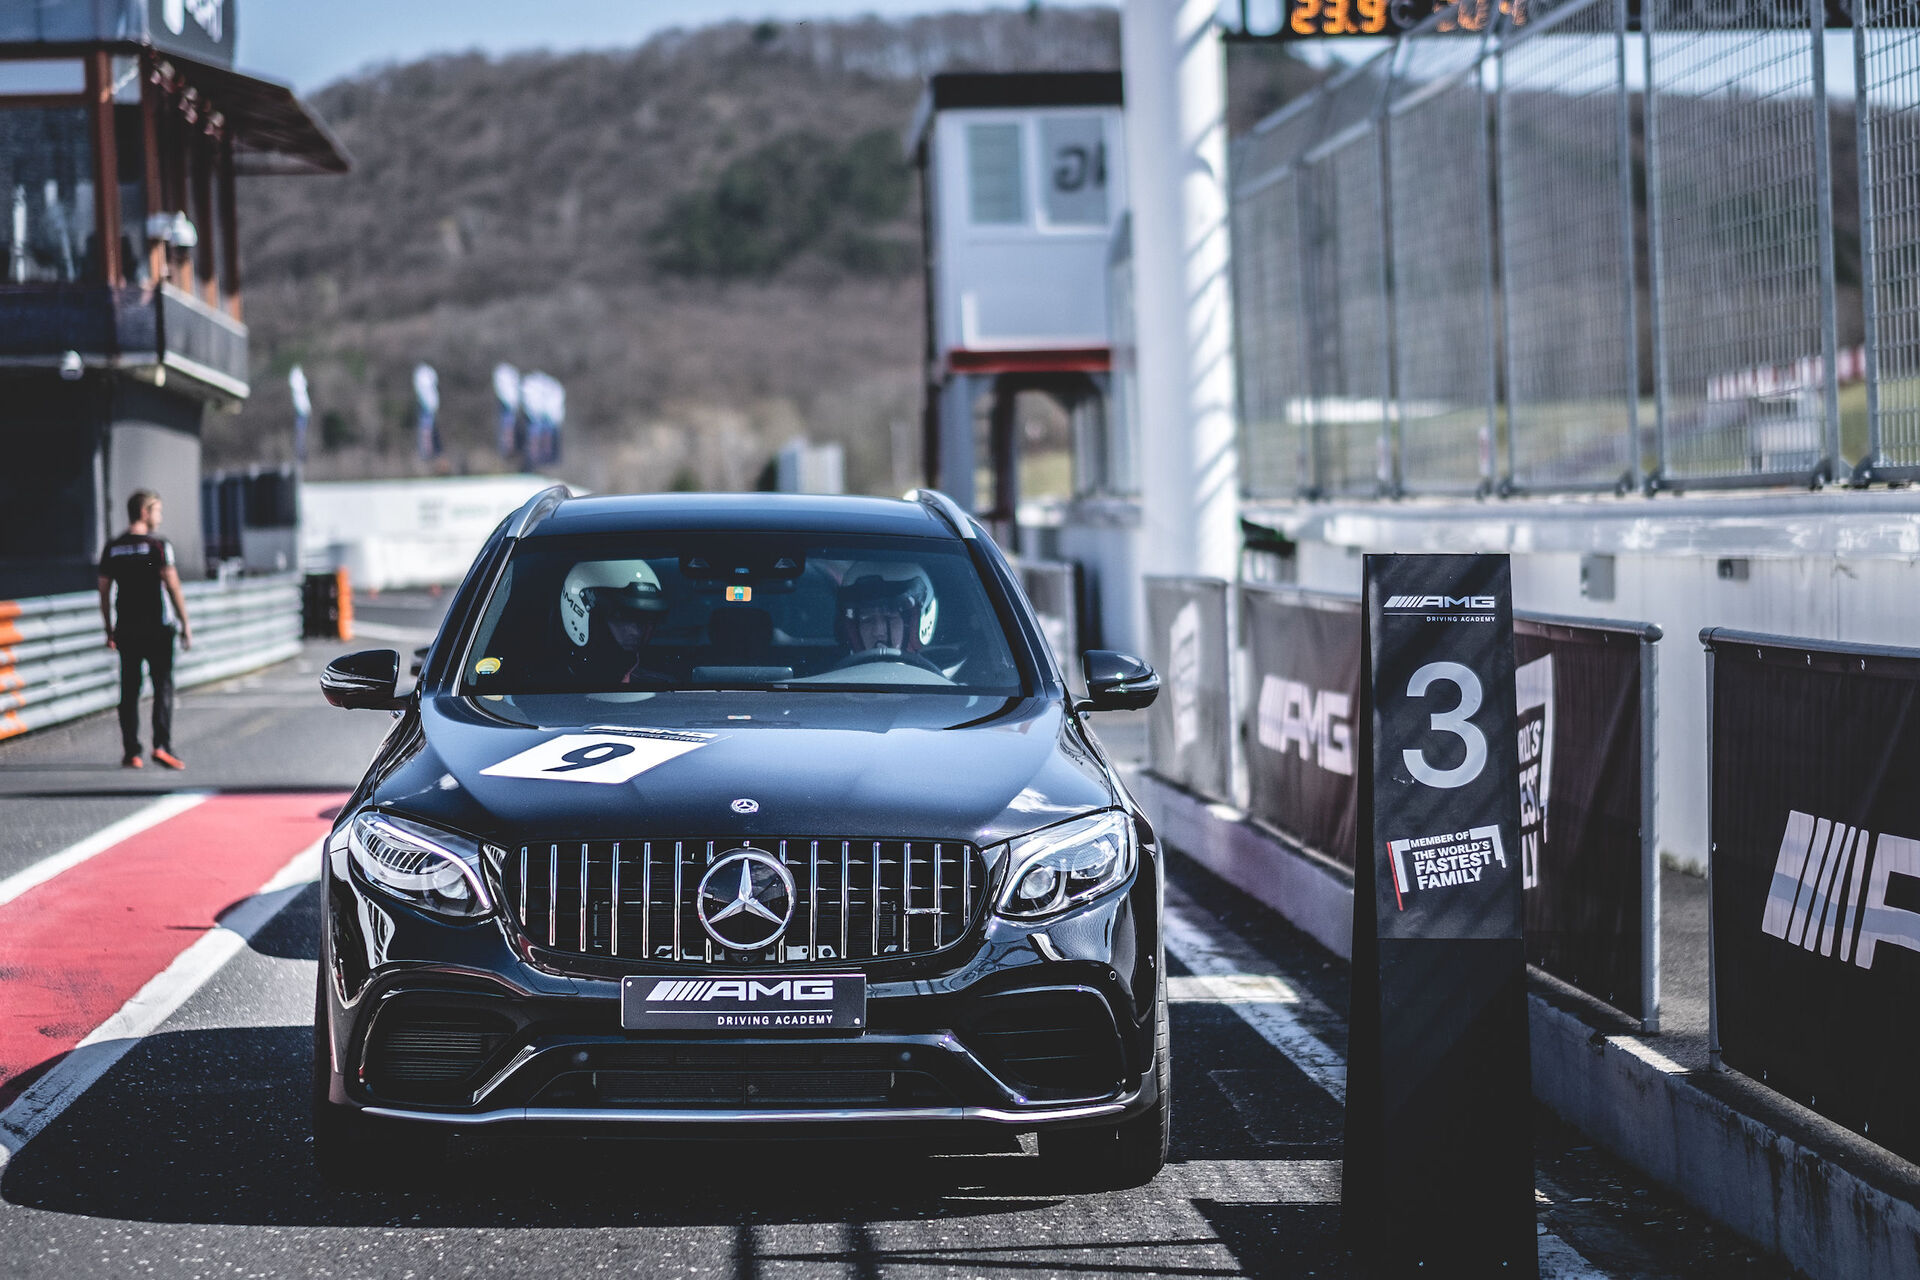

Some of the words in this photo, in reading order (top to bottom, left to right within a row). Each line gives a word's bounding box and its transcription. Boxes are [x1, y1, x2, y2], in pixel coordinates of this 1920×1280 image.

[1422, 595, 1496, 608] AMG
[1281, 682, 1353, 776] AMG
[1402, 661, 1488, 789] 3
[541, 742, 636, 773] 9
[1410, 834, 1454, 848] MEMBER
[1454, 831, 1470, 842] OF
[1413, 849, 1435, 860] THE
[1436, 840, 1491, 858] WORLD'S
[1414, 851, 1492, 876] FASTEST
[1417, 867, 1483, 892] FAMILY
[702, 980, 834, 1001] AMG
[717, 1016, 770, 1026] DRIVING
[775, 1015, 834, 1025] ACADEMY
